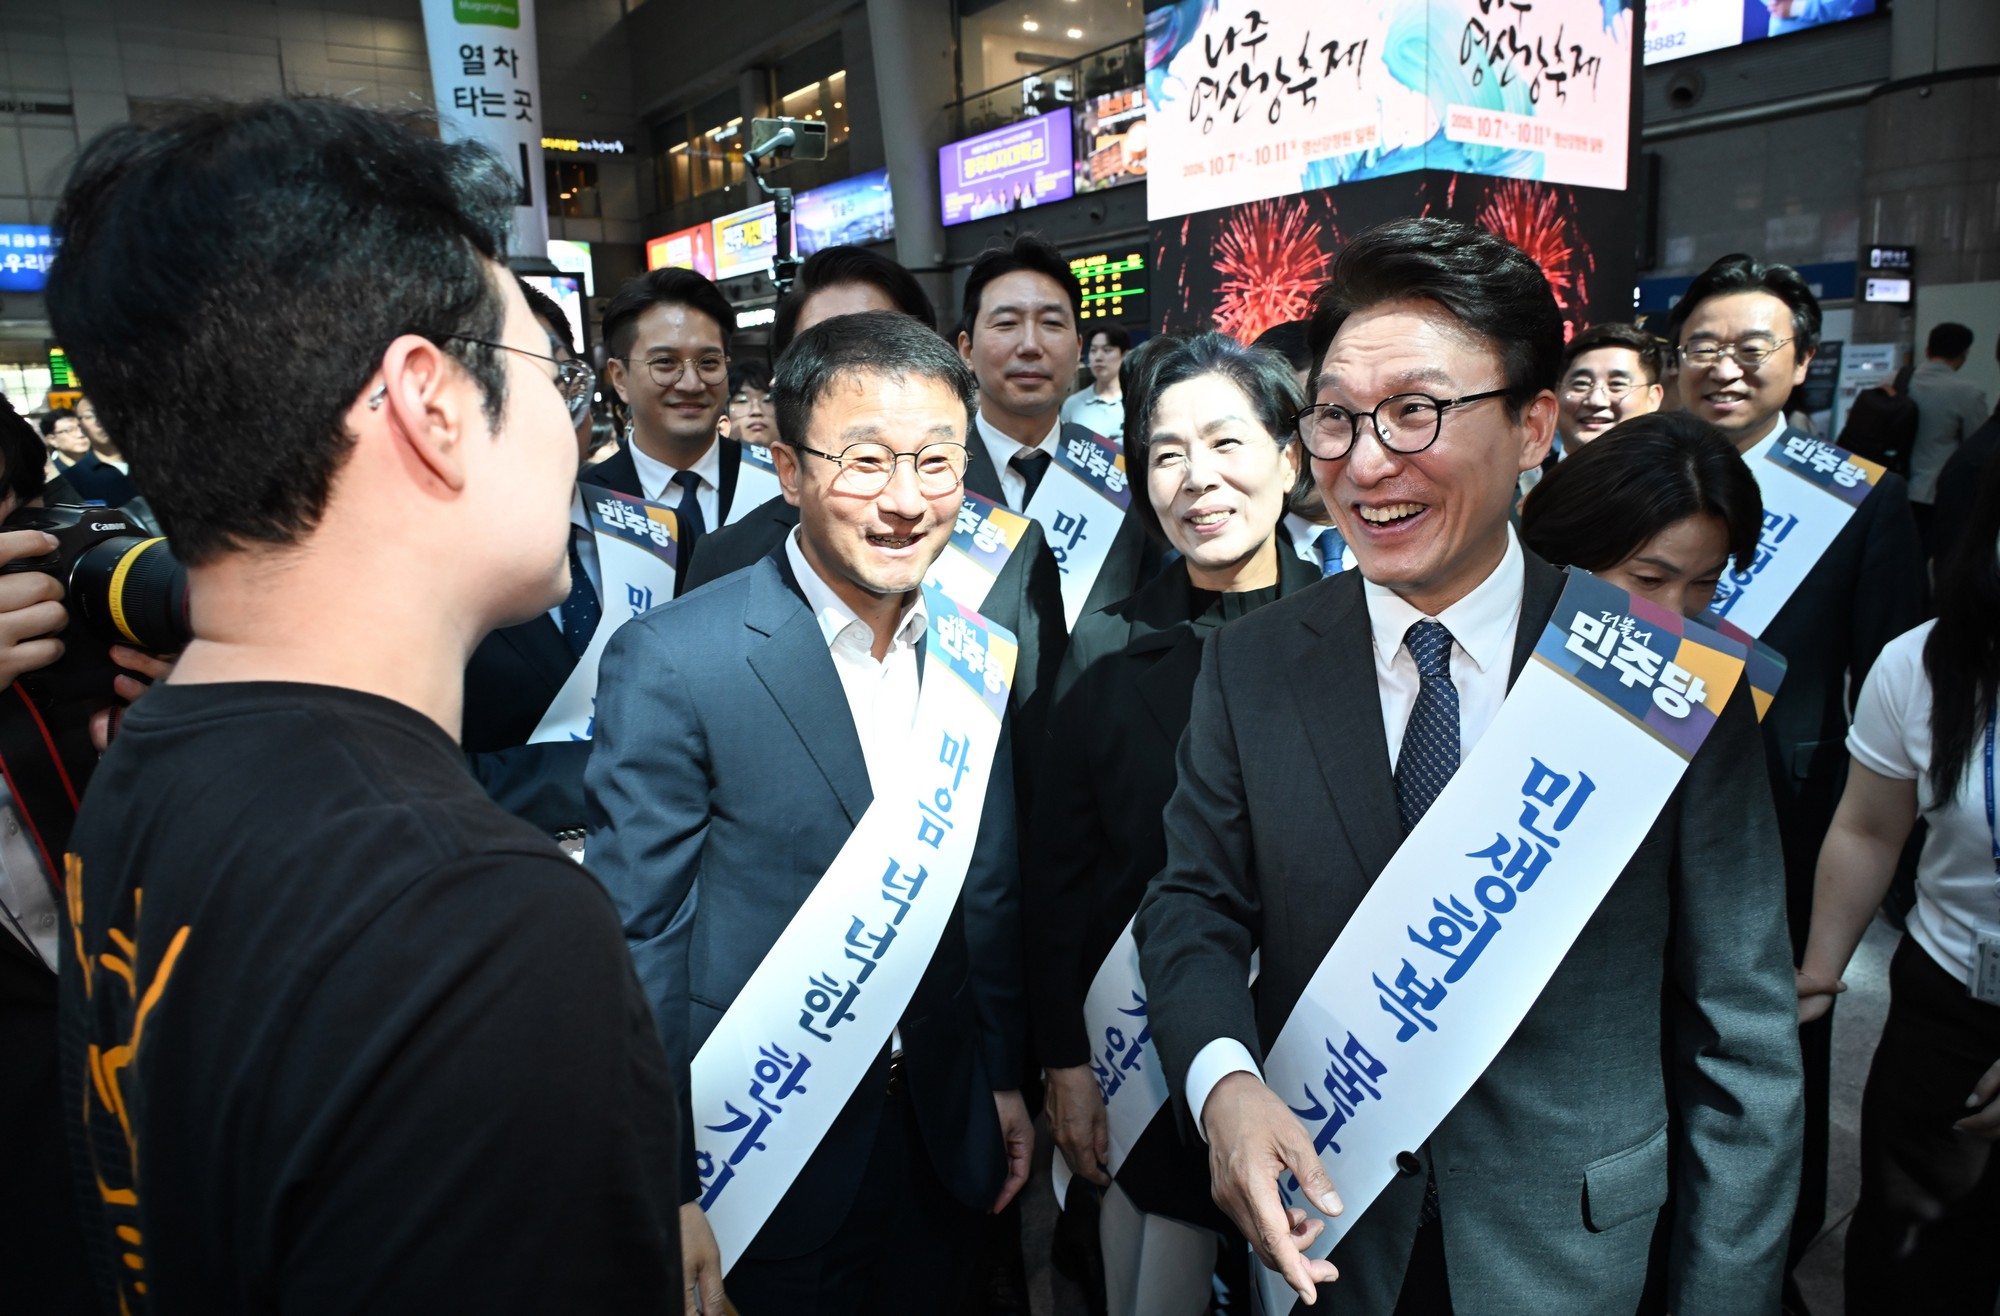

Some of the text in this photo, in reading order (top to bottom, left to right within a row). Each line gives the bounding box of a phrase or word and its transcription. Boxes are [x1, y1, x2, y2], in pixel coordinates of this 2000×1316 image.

[459, 44, 519, 78] 열차
[1205, 10, 1268, 68] 나주
[454, 87, 532, 122] 타는 곳
[1066, 439, 1129, 493] 민주당
[1782, 435, 1867, 488] 민주당
[91, 522, 126, 531] Canon
[596, 501, 671, 548] 민주당
[953, 506, 1007, 553] 주당
[937, 615, 1006, 695] 민주당
[1601, 610, 1652, 647] 더불어
[1564, 610, 1708, 719] 민주당
[917, 730, 971, 850] 마음
[1372, 756, 1597, 1043] 민생회복
[799, 857, 929, 1042] 넉넉한
